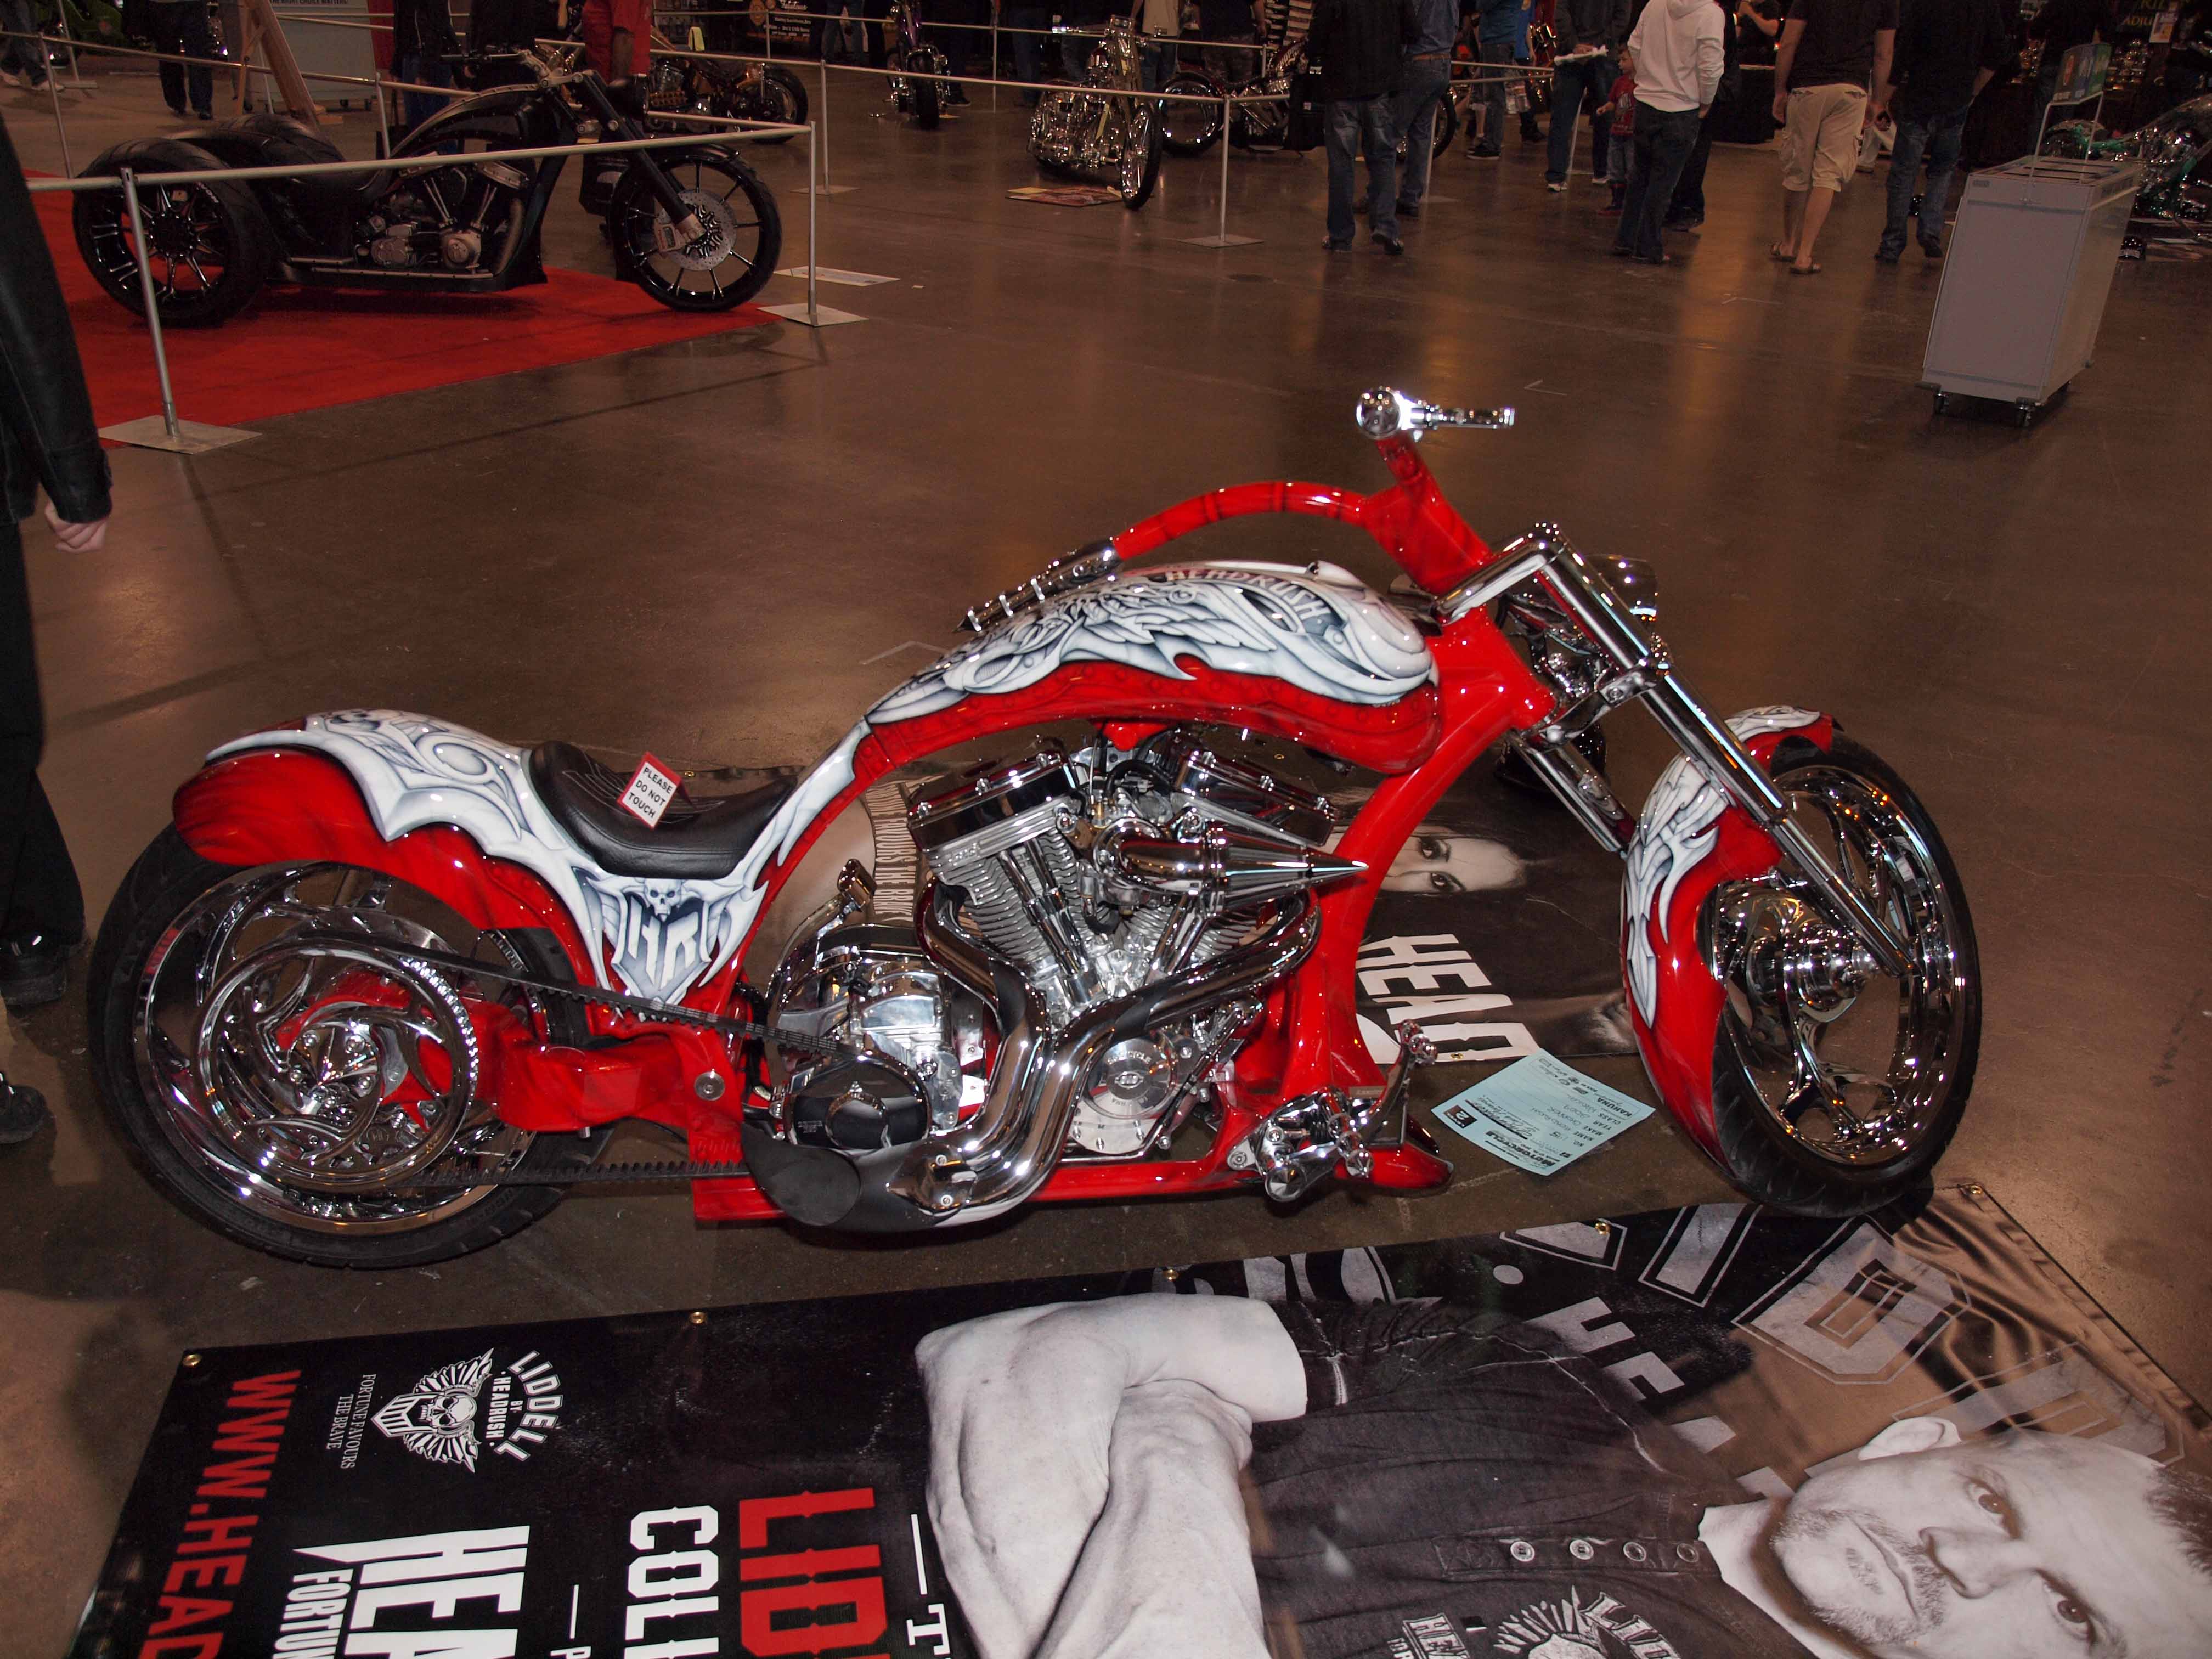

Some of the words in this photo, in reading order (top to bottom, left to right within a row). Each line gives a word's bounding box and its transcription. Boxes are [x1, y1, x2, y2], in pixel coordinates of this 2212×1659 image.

[1166, 569, 1332, 621] HEADRUSH
[636, 780, 647, 792] DO
[648, 789, 665, 806] NOT
[643, 767, 673, 794] PLEASE
[628, 792, 656, 818] TOUCH
[874, 817, 917, 864] FAVOURS
[874, 866, 917, 883] THE
[873, 889, 915, 914] BRAVE
[628, 895, 699, 989] HR
[1355, 934, 1541, 1063] HEAD
[1456, 1111, 1470, 1120] 2
[1597, 1097, 1633, 1117] KAHUNA
[1598, 1113, 1622, 1125] CLASS
[1573, 1131, 1595, 1141] NAME
[1583, 1126, 1604, 1136] MAKE
[1593, 1120, 1612, 1130] YEAR
[1486, 1131, 1556, 1166] MOTORCYCLE
[335, 1394, 354, 1415] THE
[353, 1374, 376, 1420] FORTUNE
[486, 1377, 511, 1438] HEADRUSH
[494, 1350, 563, 1462] LIDDELL
[326, 1417, 348, 1449] BRAVE
[341, 1421, 365, 1469] FAVOURS
[138, 1371, 301, 1659] WWW.HEAD
